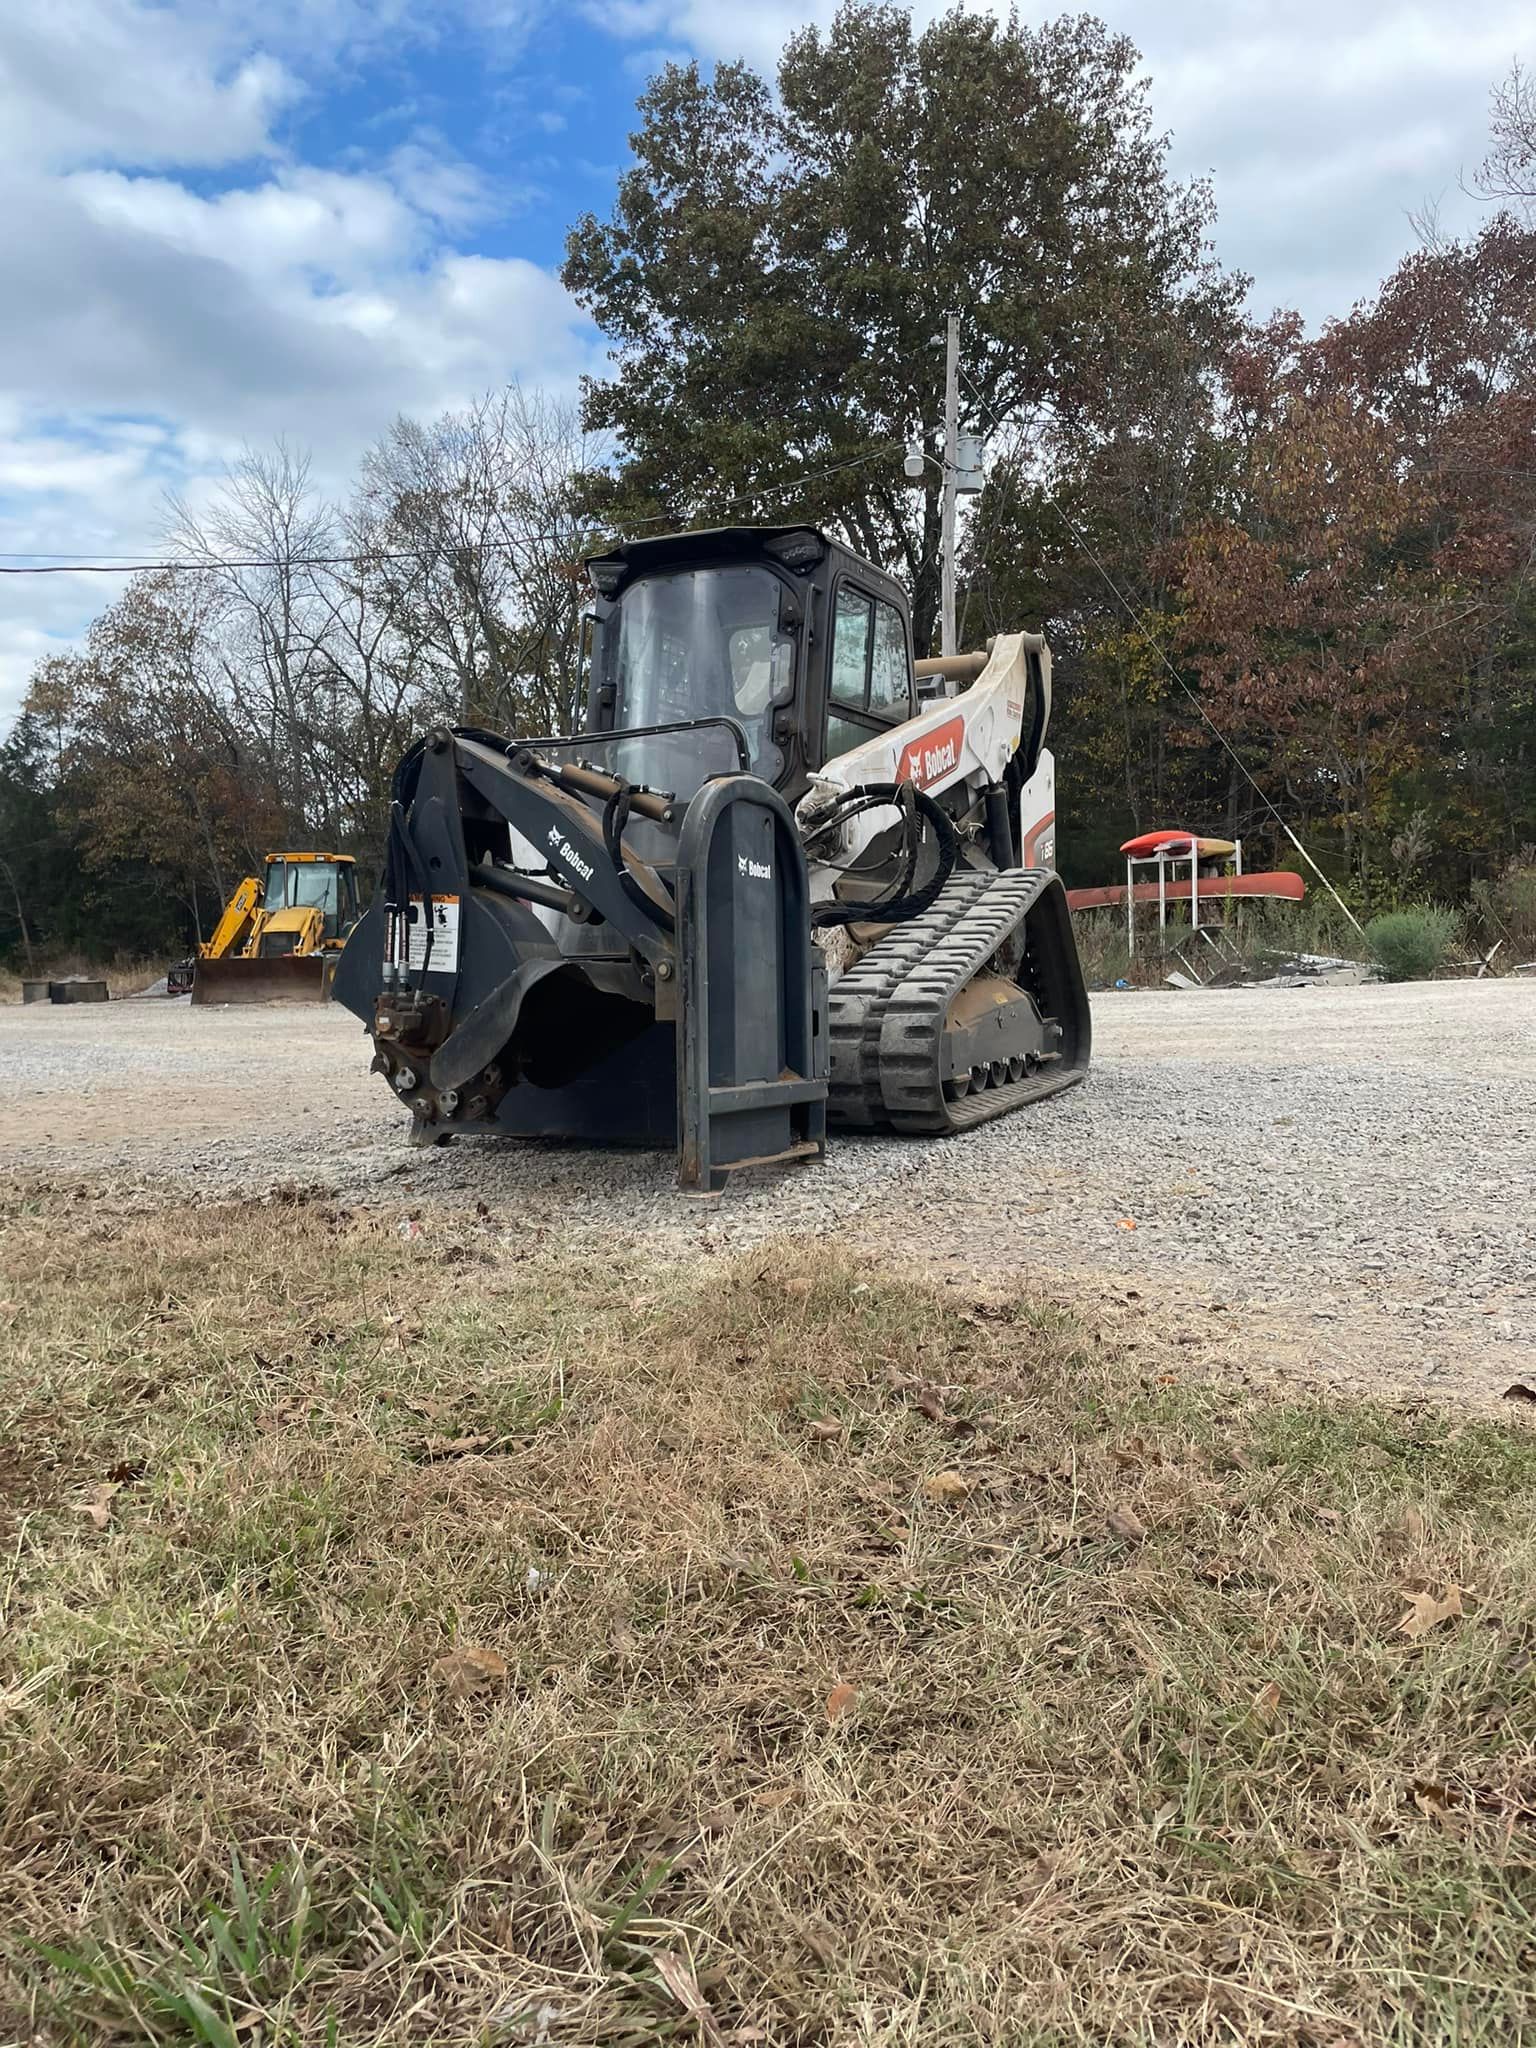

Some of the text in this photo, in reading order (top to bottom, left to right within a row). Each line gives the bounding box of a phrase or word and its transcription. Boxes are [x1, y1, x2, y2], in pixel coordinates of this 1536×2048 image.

[925, 737, 956, 780] Bobcat
[560, 842, 594, 881] Bobcat
[749, 860, 771, 880] Bobcat
